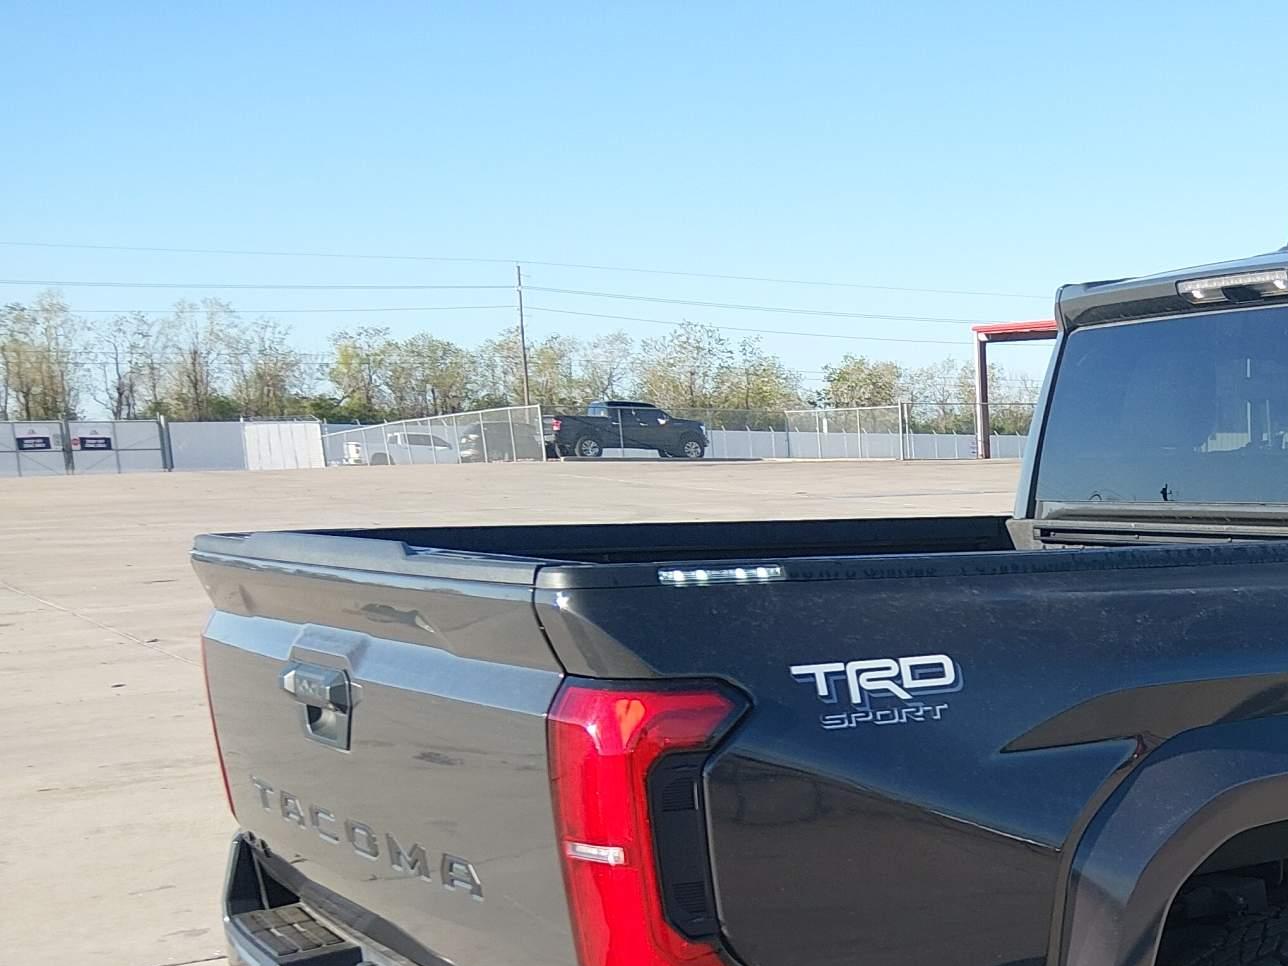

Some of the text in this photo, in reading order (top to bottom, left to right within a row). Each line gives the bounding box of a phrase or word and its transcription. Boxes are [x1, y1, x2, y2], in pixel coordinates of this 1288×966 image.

[790, 654, 956, 704] TRD
[821, 703, 948, 729] SPORT
[252, 775, 485, 903] TACOMA
